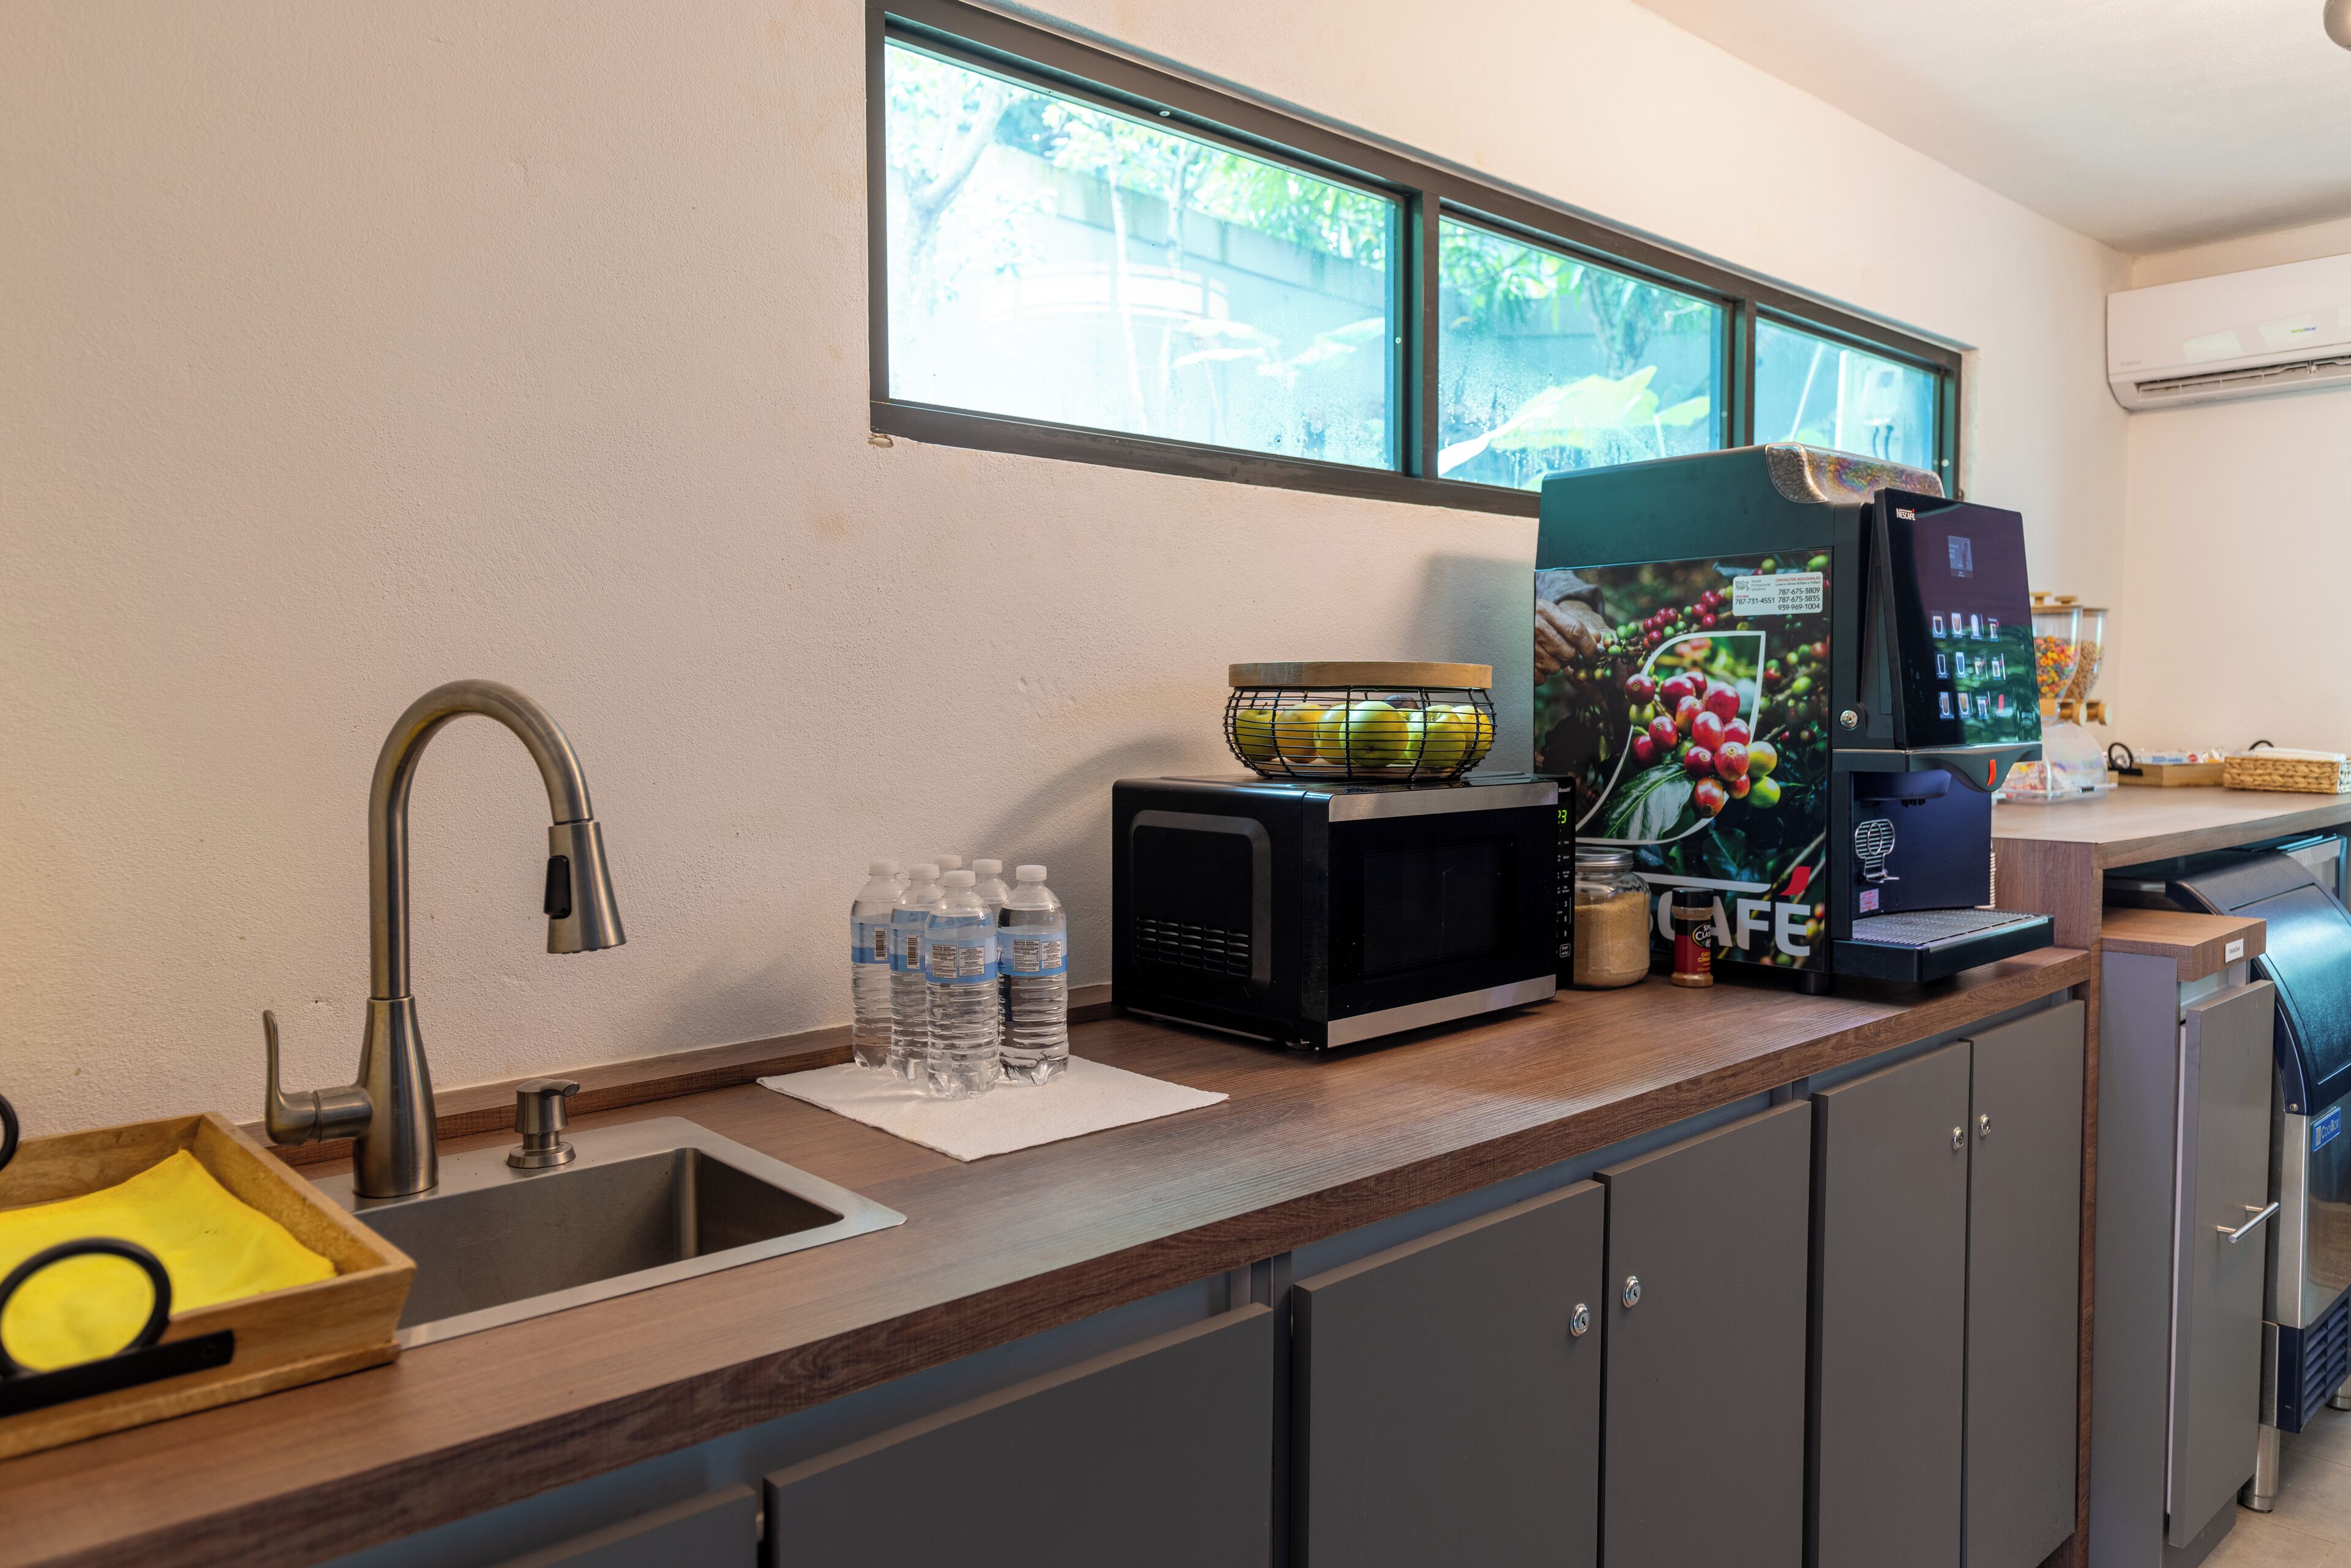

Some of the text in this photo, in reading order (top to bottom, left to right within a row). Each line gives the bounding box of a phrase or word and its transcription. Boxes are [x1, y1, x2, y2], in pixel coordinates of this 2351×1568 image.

[1896, 508, 1916, 520] NESCAFÉ
[1778, 595, 1820, 603] 787-675-3835
[1695, 931, 1711, 940] CLAS
